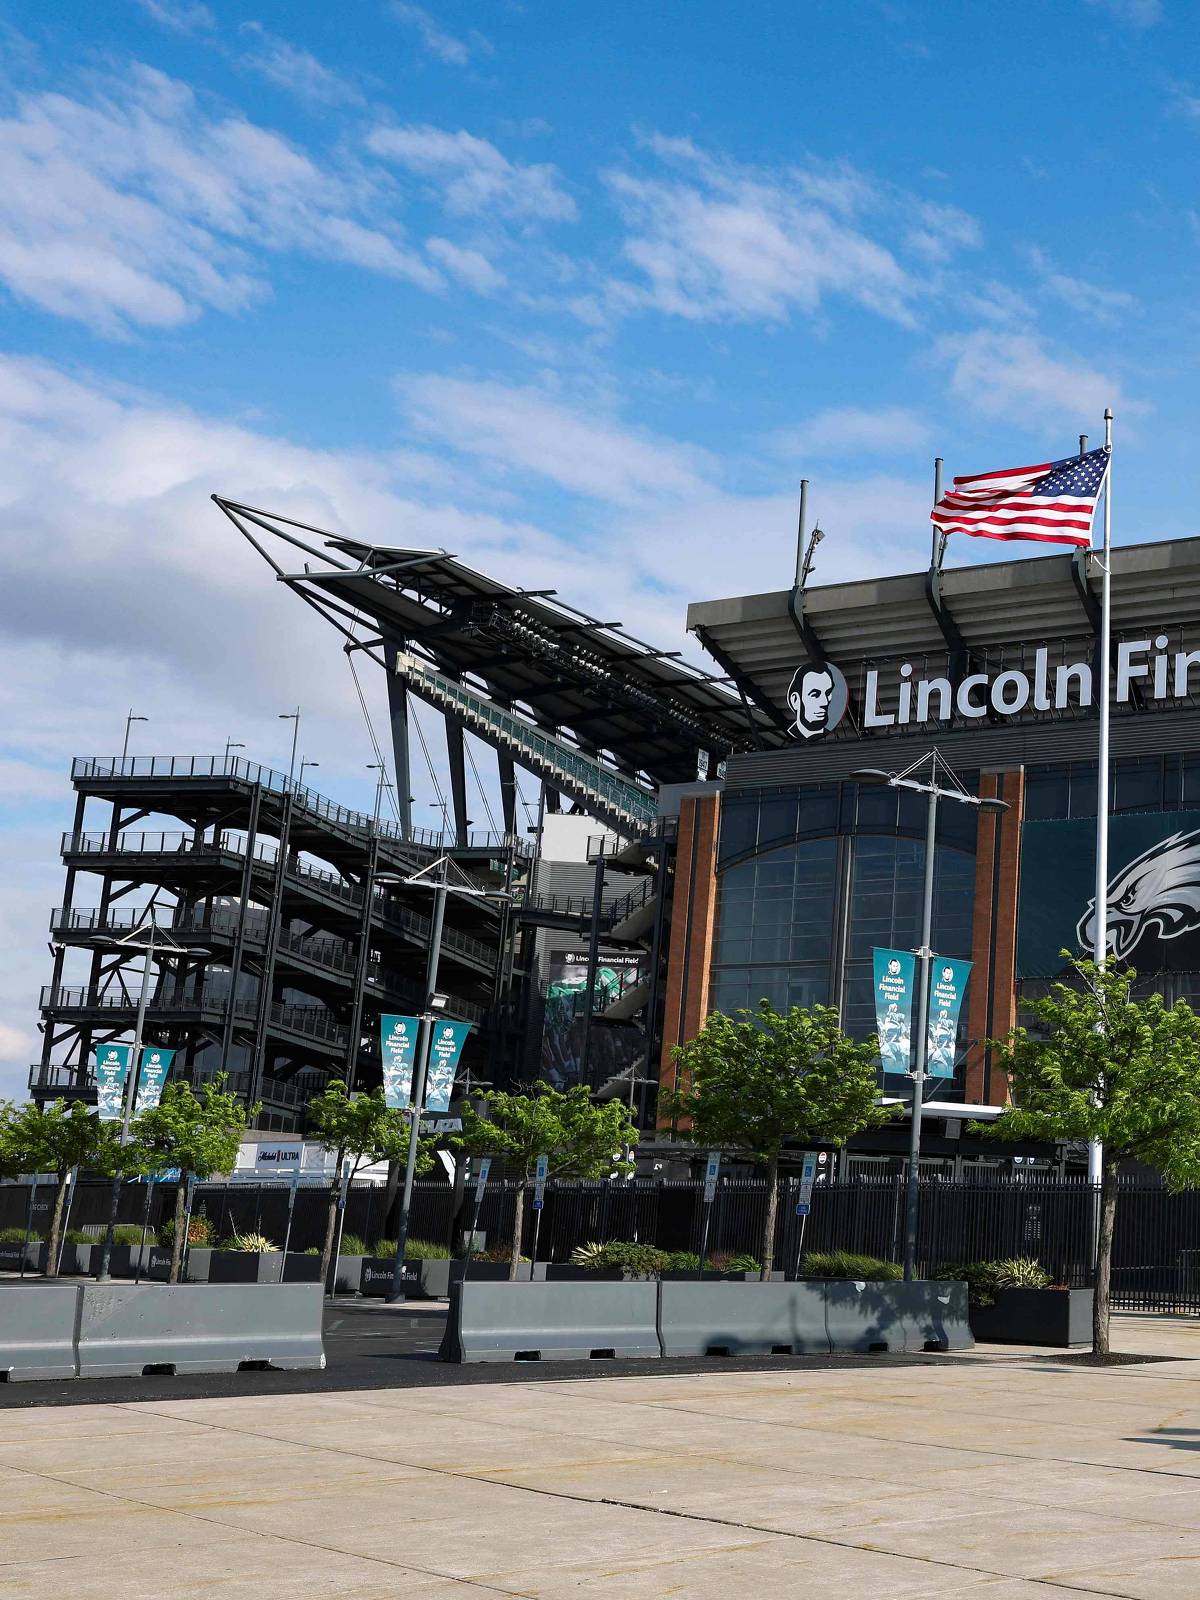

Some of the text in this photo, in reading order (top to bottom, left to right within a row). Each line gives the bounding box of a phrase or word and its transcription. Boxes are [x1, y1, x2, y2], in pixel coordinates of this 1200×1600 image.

[864, 647, 1093, 728] Lincoln
[882, 976, 904, 984] Lincoln
[879, 984, 906, 993] Financial
[936, 982, 955, 991] Lincoln
[884, 992, 899, 1001] Field
[934, 990, 957, 1000] Financial
[938, 999, 951, 1007] Field
[388, 1034, 409, 1042] Lincoln
[385, 1041, 410, 1049] Financial
[281, 1151, 300, 1161] ULTRA
[371, 1270, 386, 1279] Lincoln
[406, 1272, 418, 1281] Field
